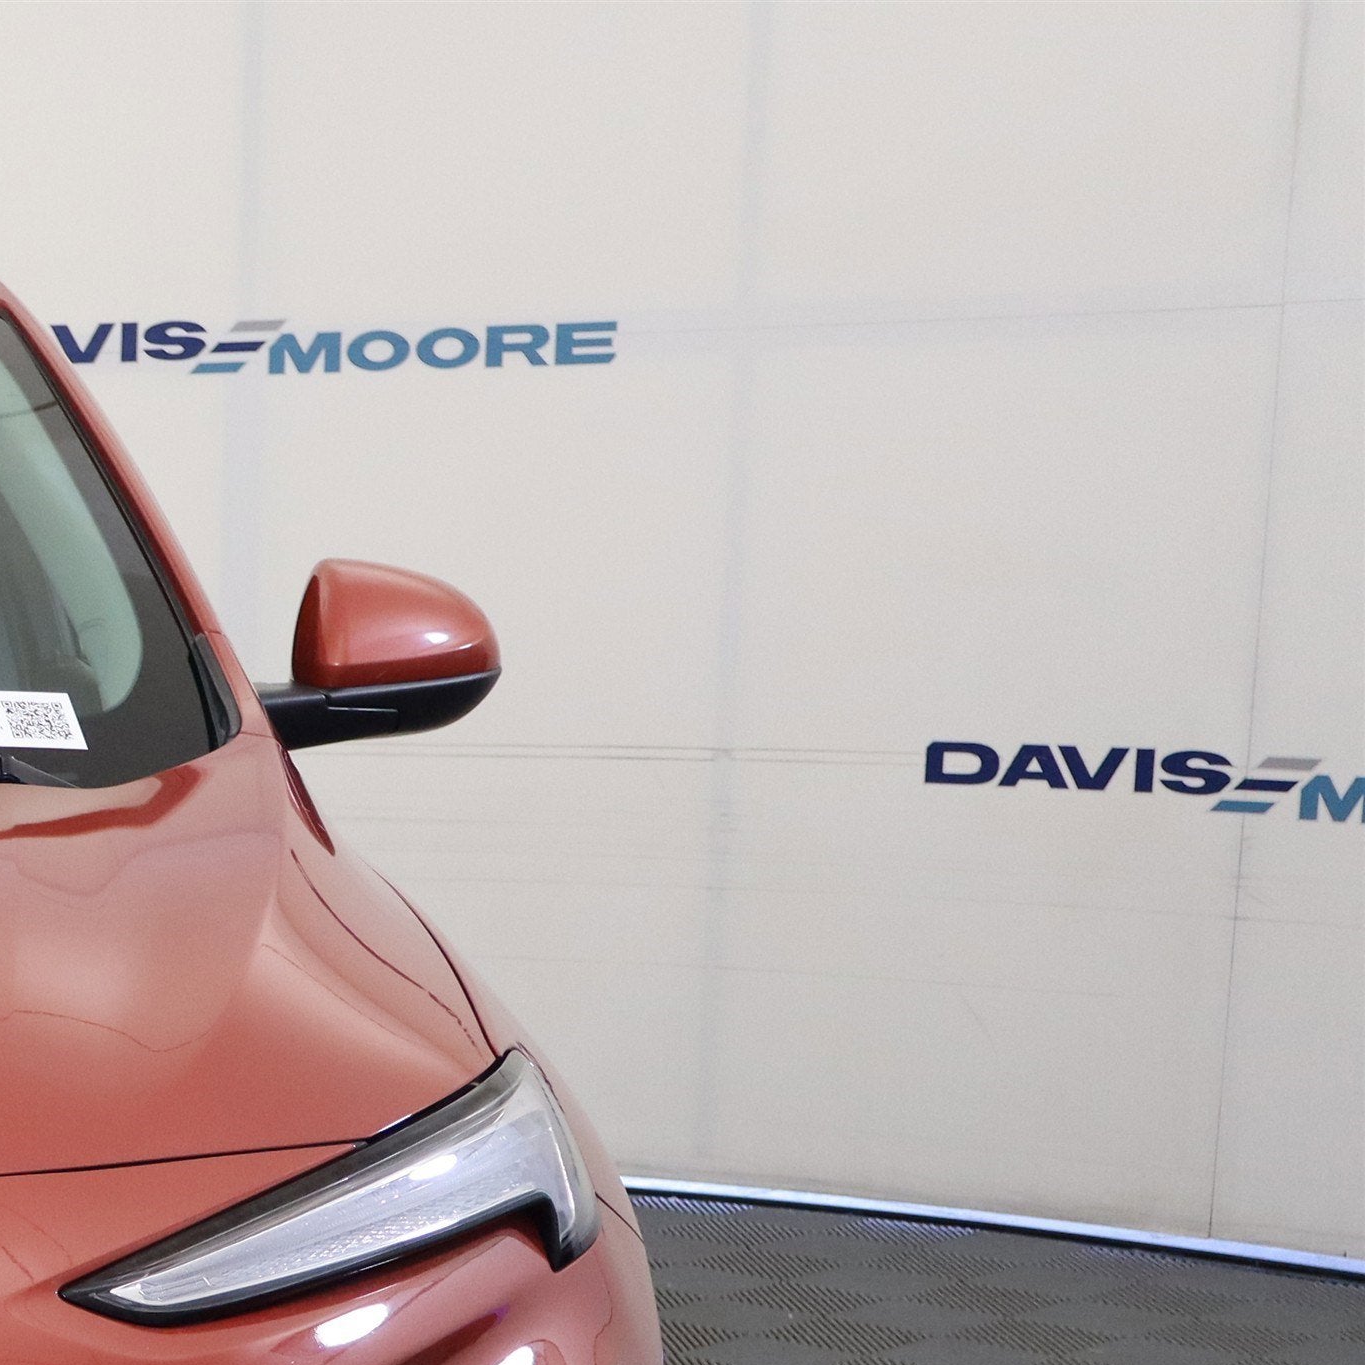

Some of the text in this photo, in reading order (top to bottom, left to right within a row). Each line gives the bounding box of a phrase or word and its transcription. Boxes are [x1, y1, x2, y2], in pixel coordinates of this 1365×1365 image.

[51, 320, 618, 375] VIS MOORE
[924, 741, 1233, 796] DAVIS
